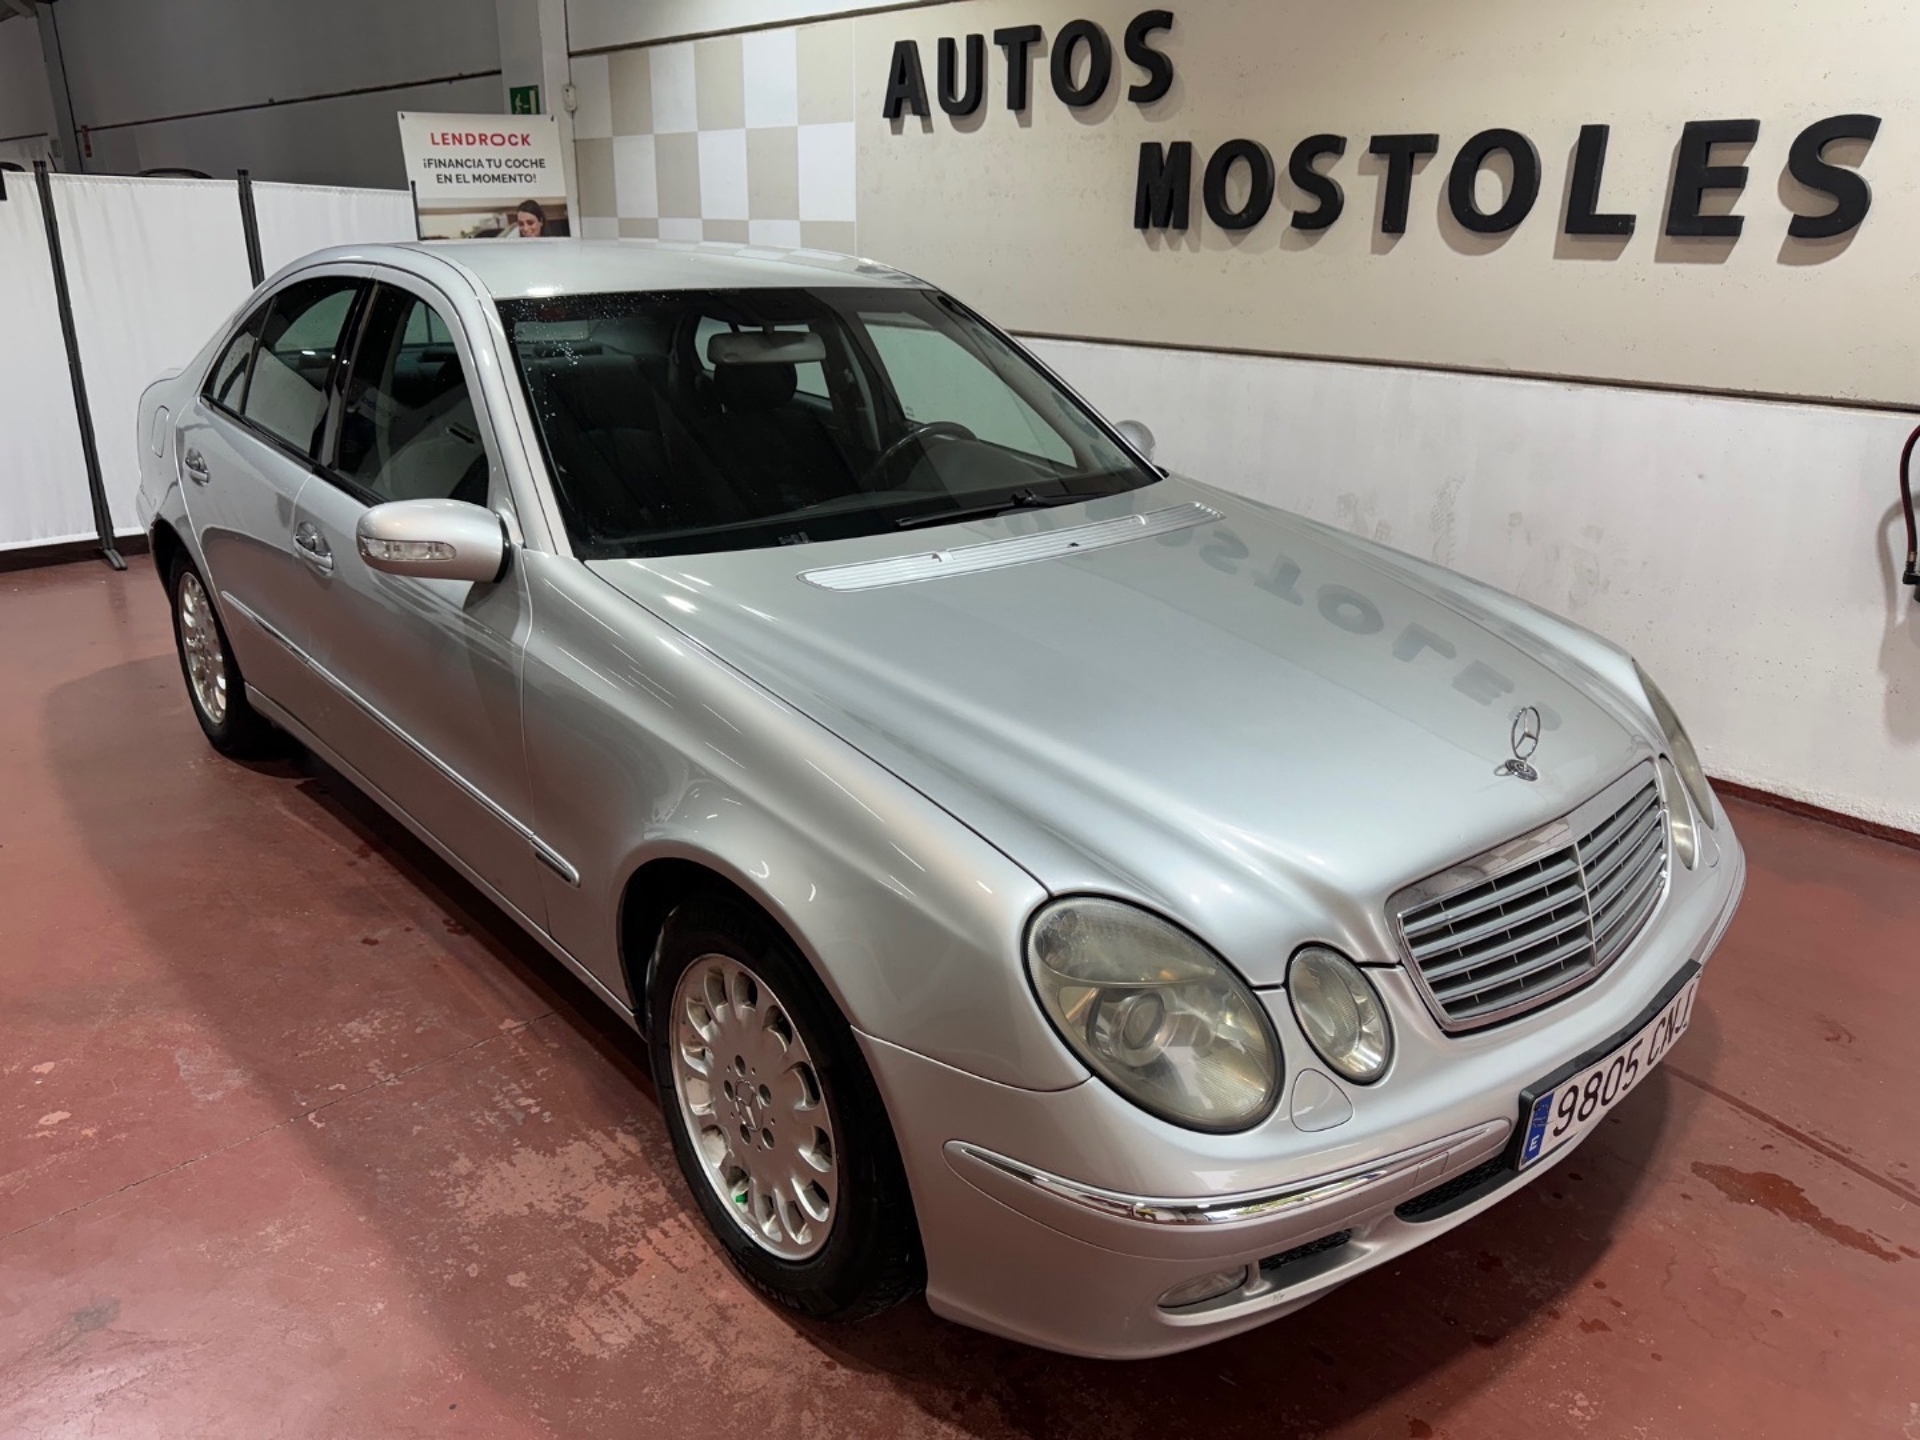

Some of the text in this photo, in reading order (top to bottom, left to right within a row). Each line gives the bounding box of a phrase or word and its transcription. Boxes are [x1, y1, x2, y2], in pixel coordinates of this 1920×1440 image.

[882, 10, 1174, 120] AUTOS
[430, 132, 531, 146] LENDROCK
[423, 158, 546, 169] ¡FINANCIA TU COCHE
[436, 173, 537, 184] EN EL MOMENTO!
[1134, 113, 1881, 239] MOSTOLES
[1553, 1037, 1643, 1138] 9805
[1529, 1134, 1540, 1152] E
